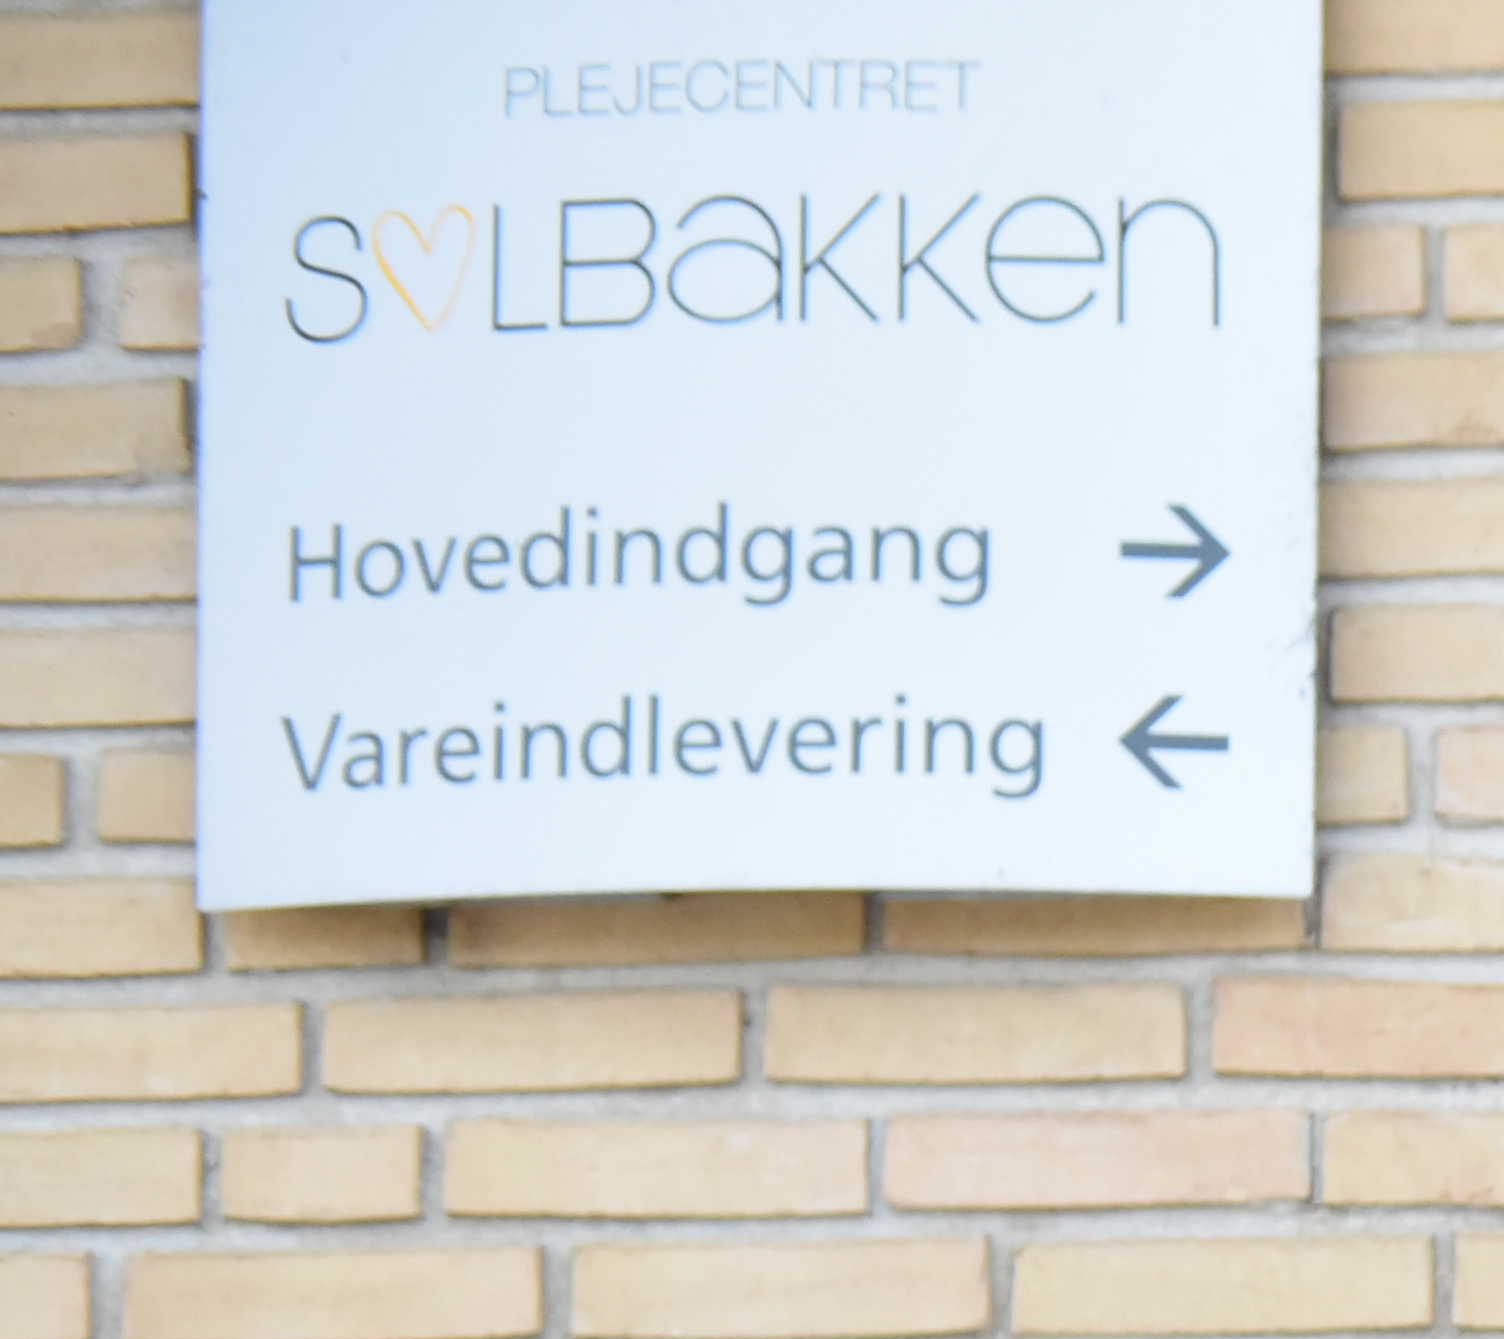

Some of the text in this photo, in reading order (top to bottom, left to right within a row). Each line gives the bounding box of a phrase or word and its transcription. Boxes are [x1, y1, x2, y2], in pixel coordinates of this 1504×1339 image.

[503, 58, 981, 118] PLEJECENTRET
[289, 500, 990, 608] Hovedindgang
[280, 693, 1044, 800] Vareindlevering
